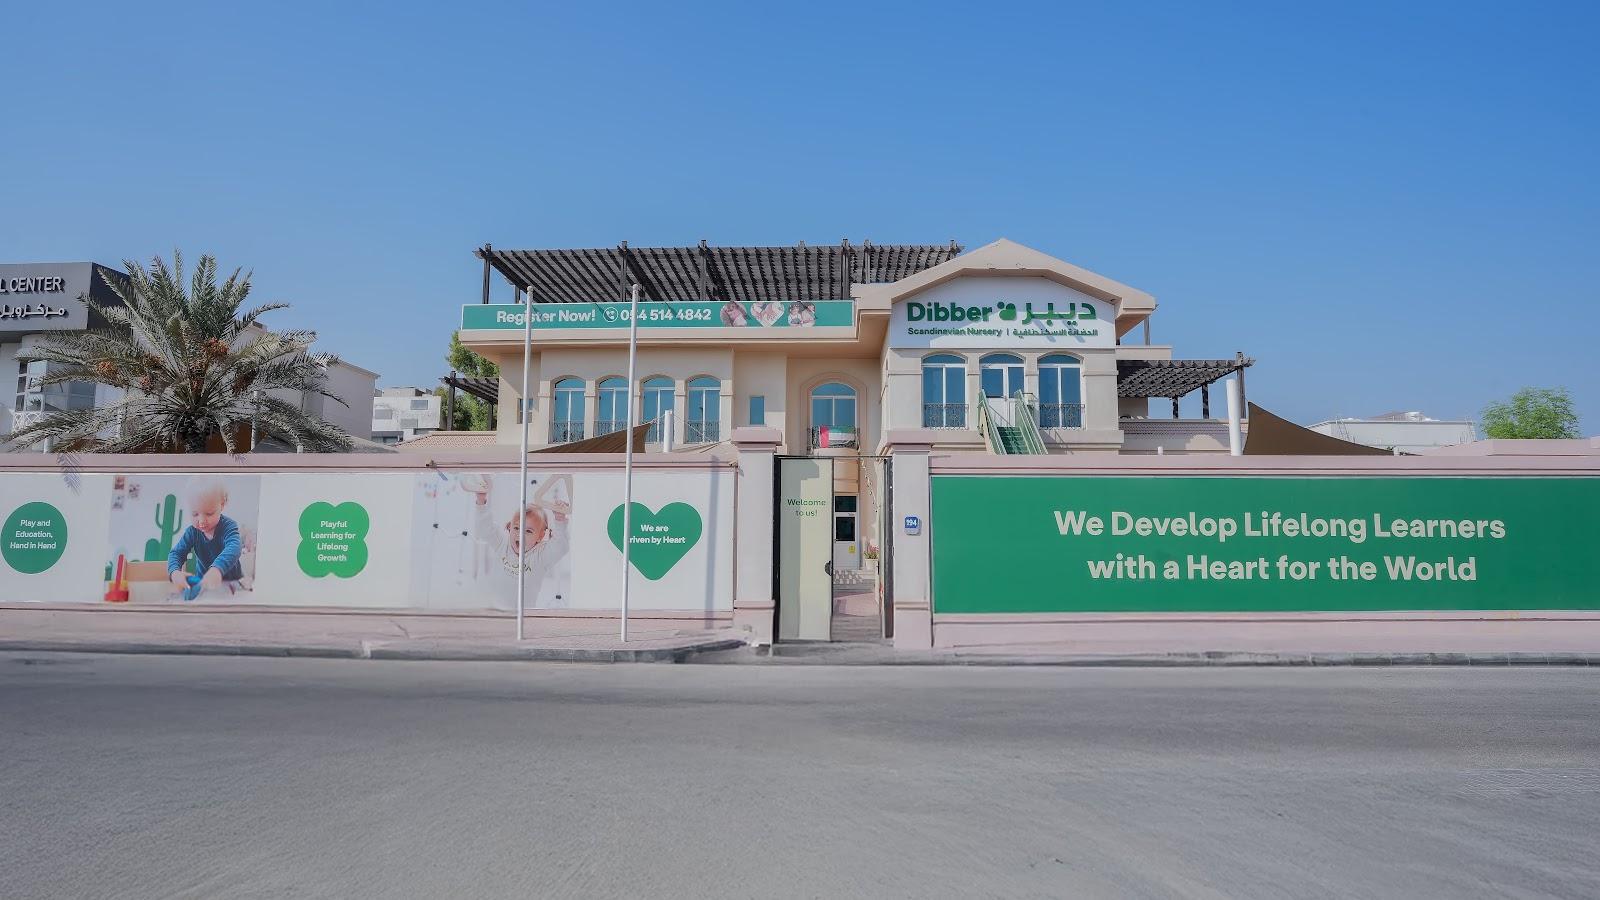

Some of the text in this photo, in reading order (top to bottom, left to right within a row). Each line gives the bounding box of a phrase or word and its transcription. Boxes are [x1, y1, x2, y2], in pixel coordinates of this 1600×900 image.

[0, 276, 62, 292] L CENTER
[558, 309, 596, 322] Now!
[650, 308, 673, 321] 514
[676, 308, 712, 321] 4842
[907, 302, 993, 322] Dibber
[1022, 302, 1096, 326] ديبر
[907, 327, 1002, 337] Scandinavian Nursery
[787, 498, 826, 506] Welcome
[20, 519, 51, 528] Play and
[320, 520, 347, 529] Playful
[640, 524, 654, 532] We
[1054, 510, 1506, 543] We Develop Lifelong Learners
[15, 530, 53, 538] Education,
[310, 531, 356, 540] Learning for
[629, 535, 686, 545] riven by Heart
[10, 541, 57, 549] Hand in Hand
[317, 542, 349, 551] Lifelong
[317, 554, 347, 562] Growth
[1087, 552, 1477, 581] with a Heart for the World
